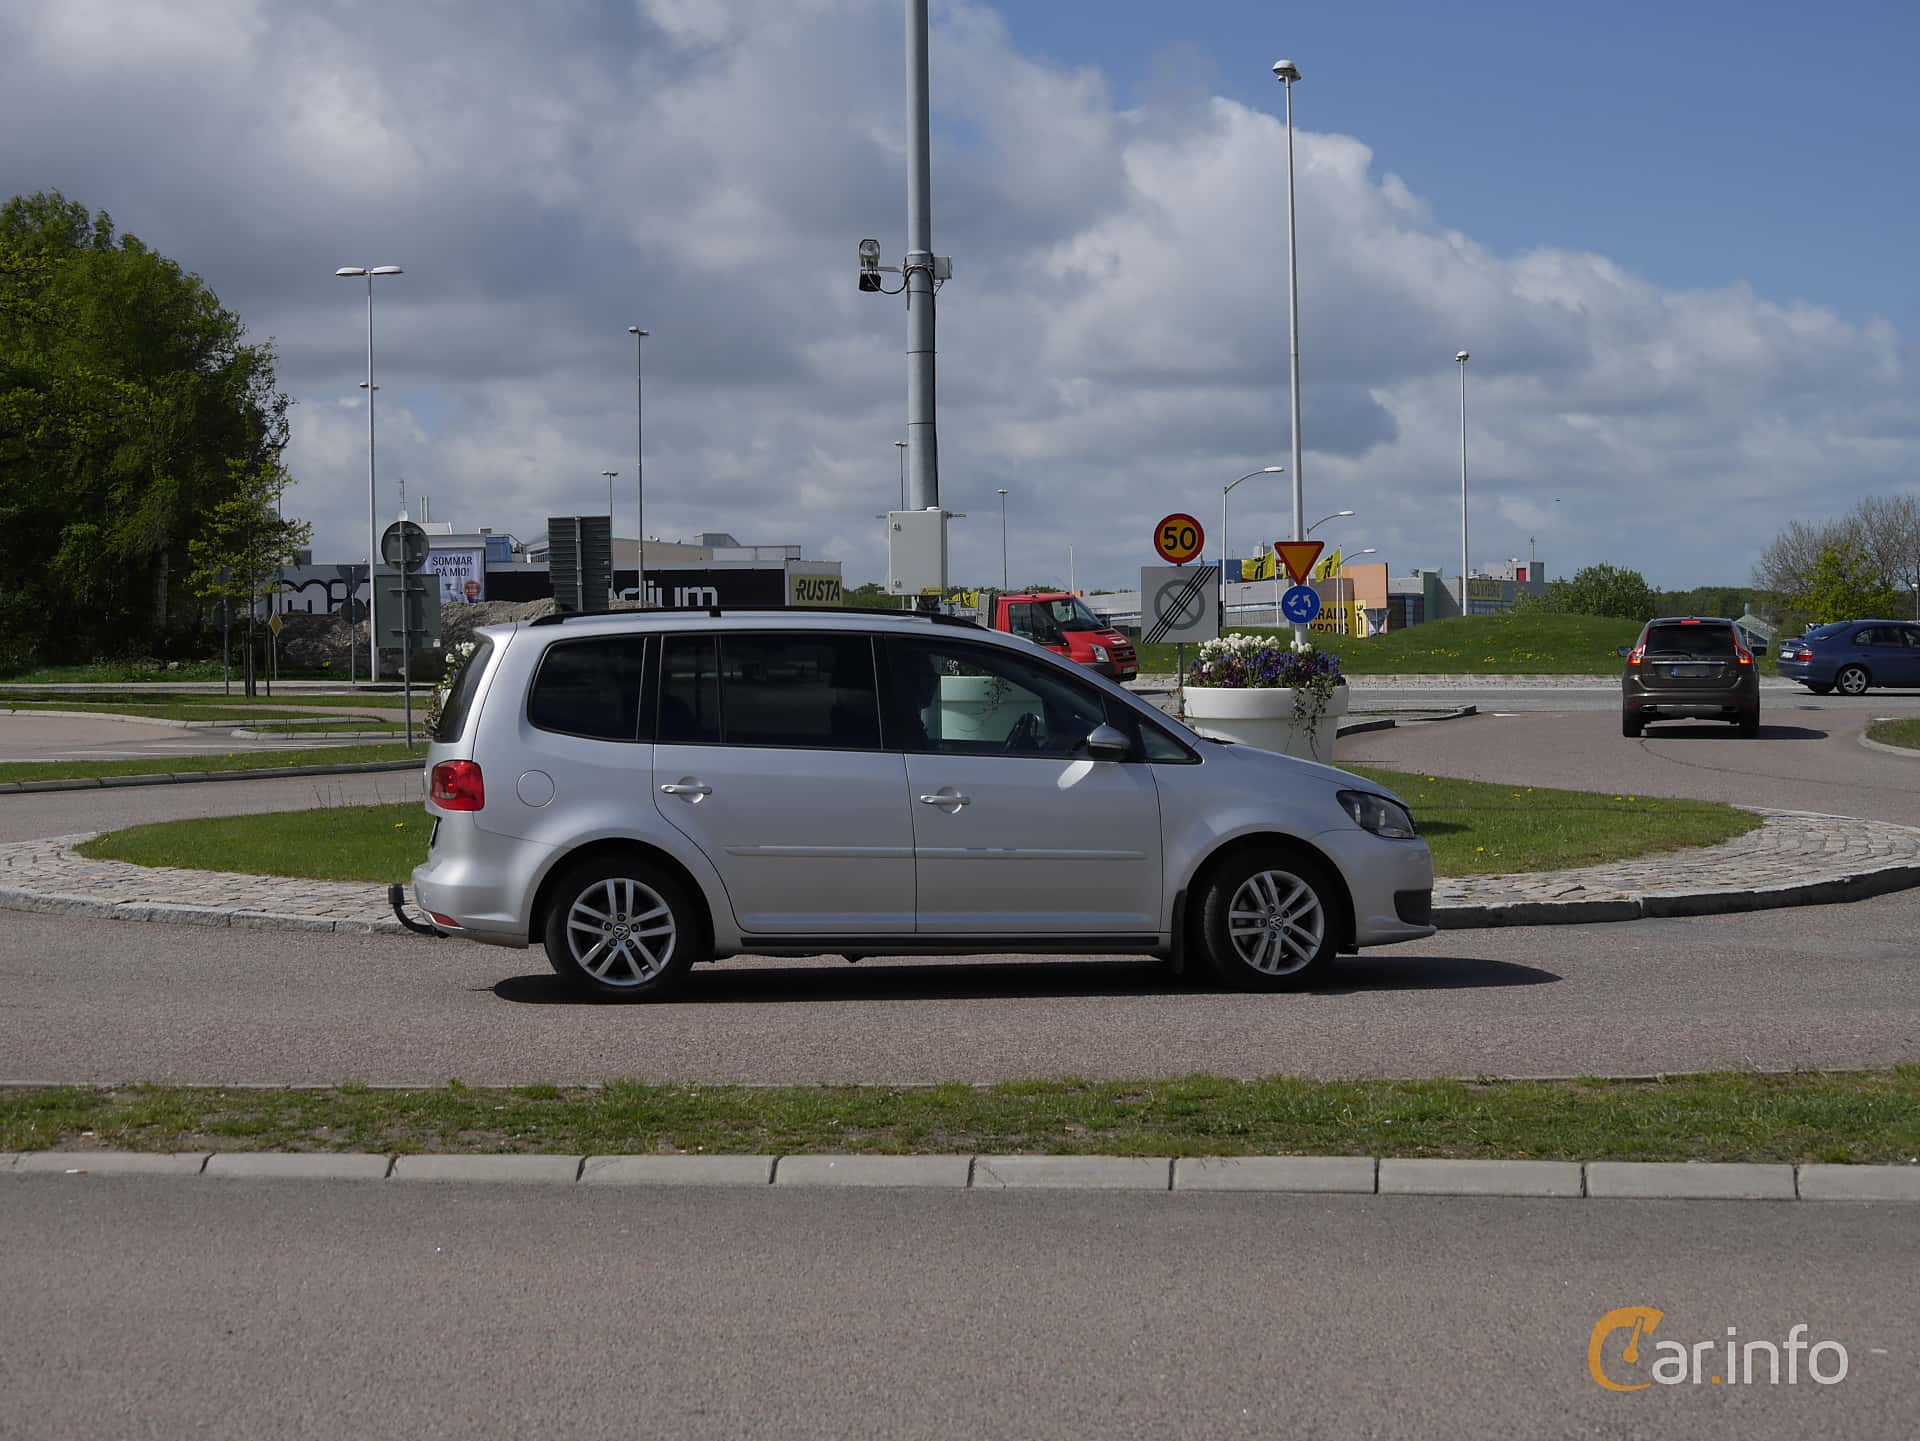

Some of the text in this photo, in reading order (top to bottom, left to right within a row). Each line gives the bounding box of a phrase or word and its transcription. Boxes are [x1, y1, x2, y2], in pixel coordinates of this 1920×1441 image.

[1163, 526, 1197, 551] 50
[432, 556, 473, 566] SOMMAR
[435, 566, 470, 577] PÅ MIO!
[608, 580, 718, 607] dium
[795, 579, 841, 602] RUSTA
[1315, 607, 1348, 620] RALD
